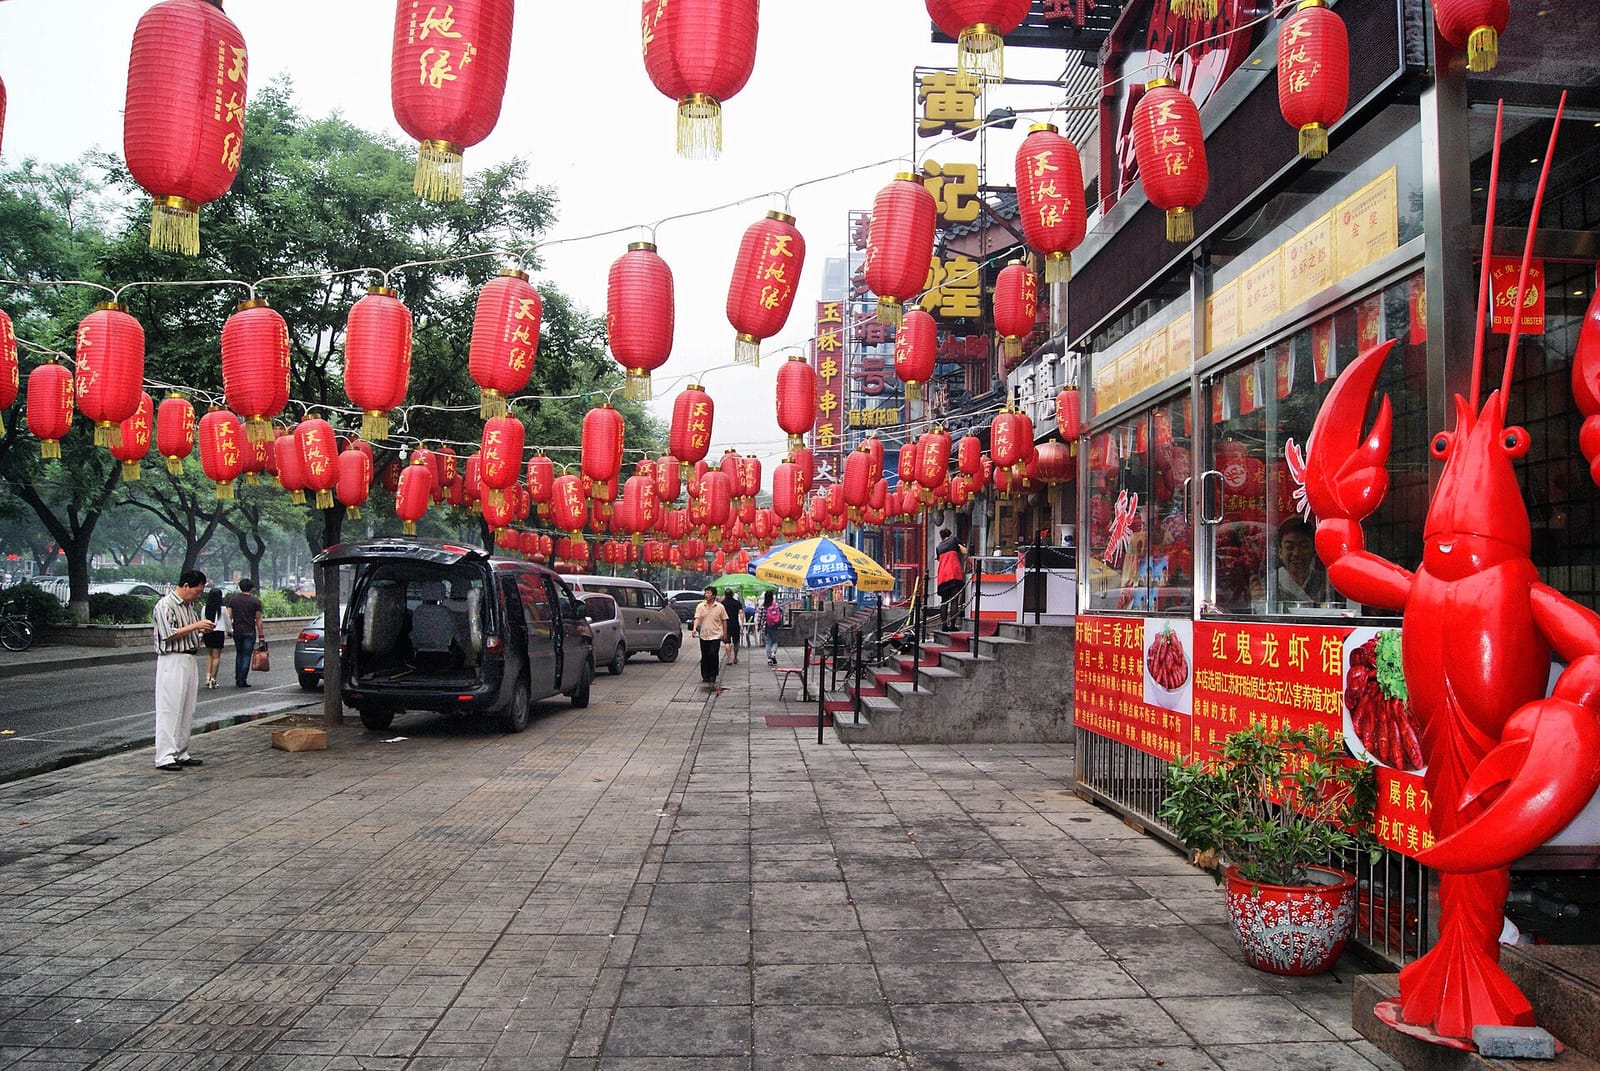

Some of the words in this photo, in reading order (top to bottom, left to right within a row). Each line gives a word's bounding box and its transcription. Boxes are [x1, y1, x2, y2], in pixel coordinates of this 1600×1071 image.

[1287, 18, 1311, 94] 天地缘
[1156, 99, 1188, 177] 天地缘
[917, 71, 982, 318] 黄记煌
[1033, 150, 1063, 228] 天地缘
[760, 235, 793, 311] 天地缘
[1493, 263, 1540, 280] 红鬼虾
[508, 298, 535, 372] 天地缘
[817, 302, 842, 448] 玉林串串香
[219, 421, 239, 467] 天地缘
[691, 402, 708, 448] 天地缘
[305, 429, 325, 475] 天地缘
[485, 430, 501, 477] 天地缘
[926, 443, 939, 478] 天地缘
[566, 481, 582, 517] 天地缘
[1075, 621, 1144, 652] 盱眙十三香龙虾
[1211, 628, 1344, 676] 红鬼龙虾馆
[1389, 779, 1432, 815] 屡食不
